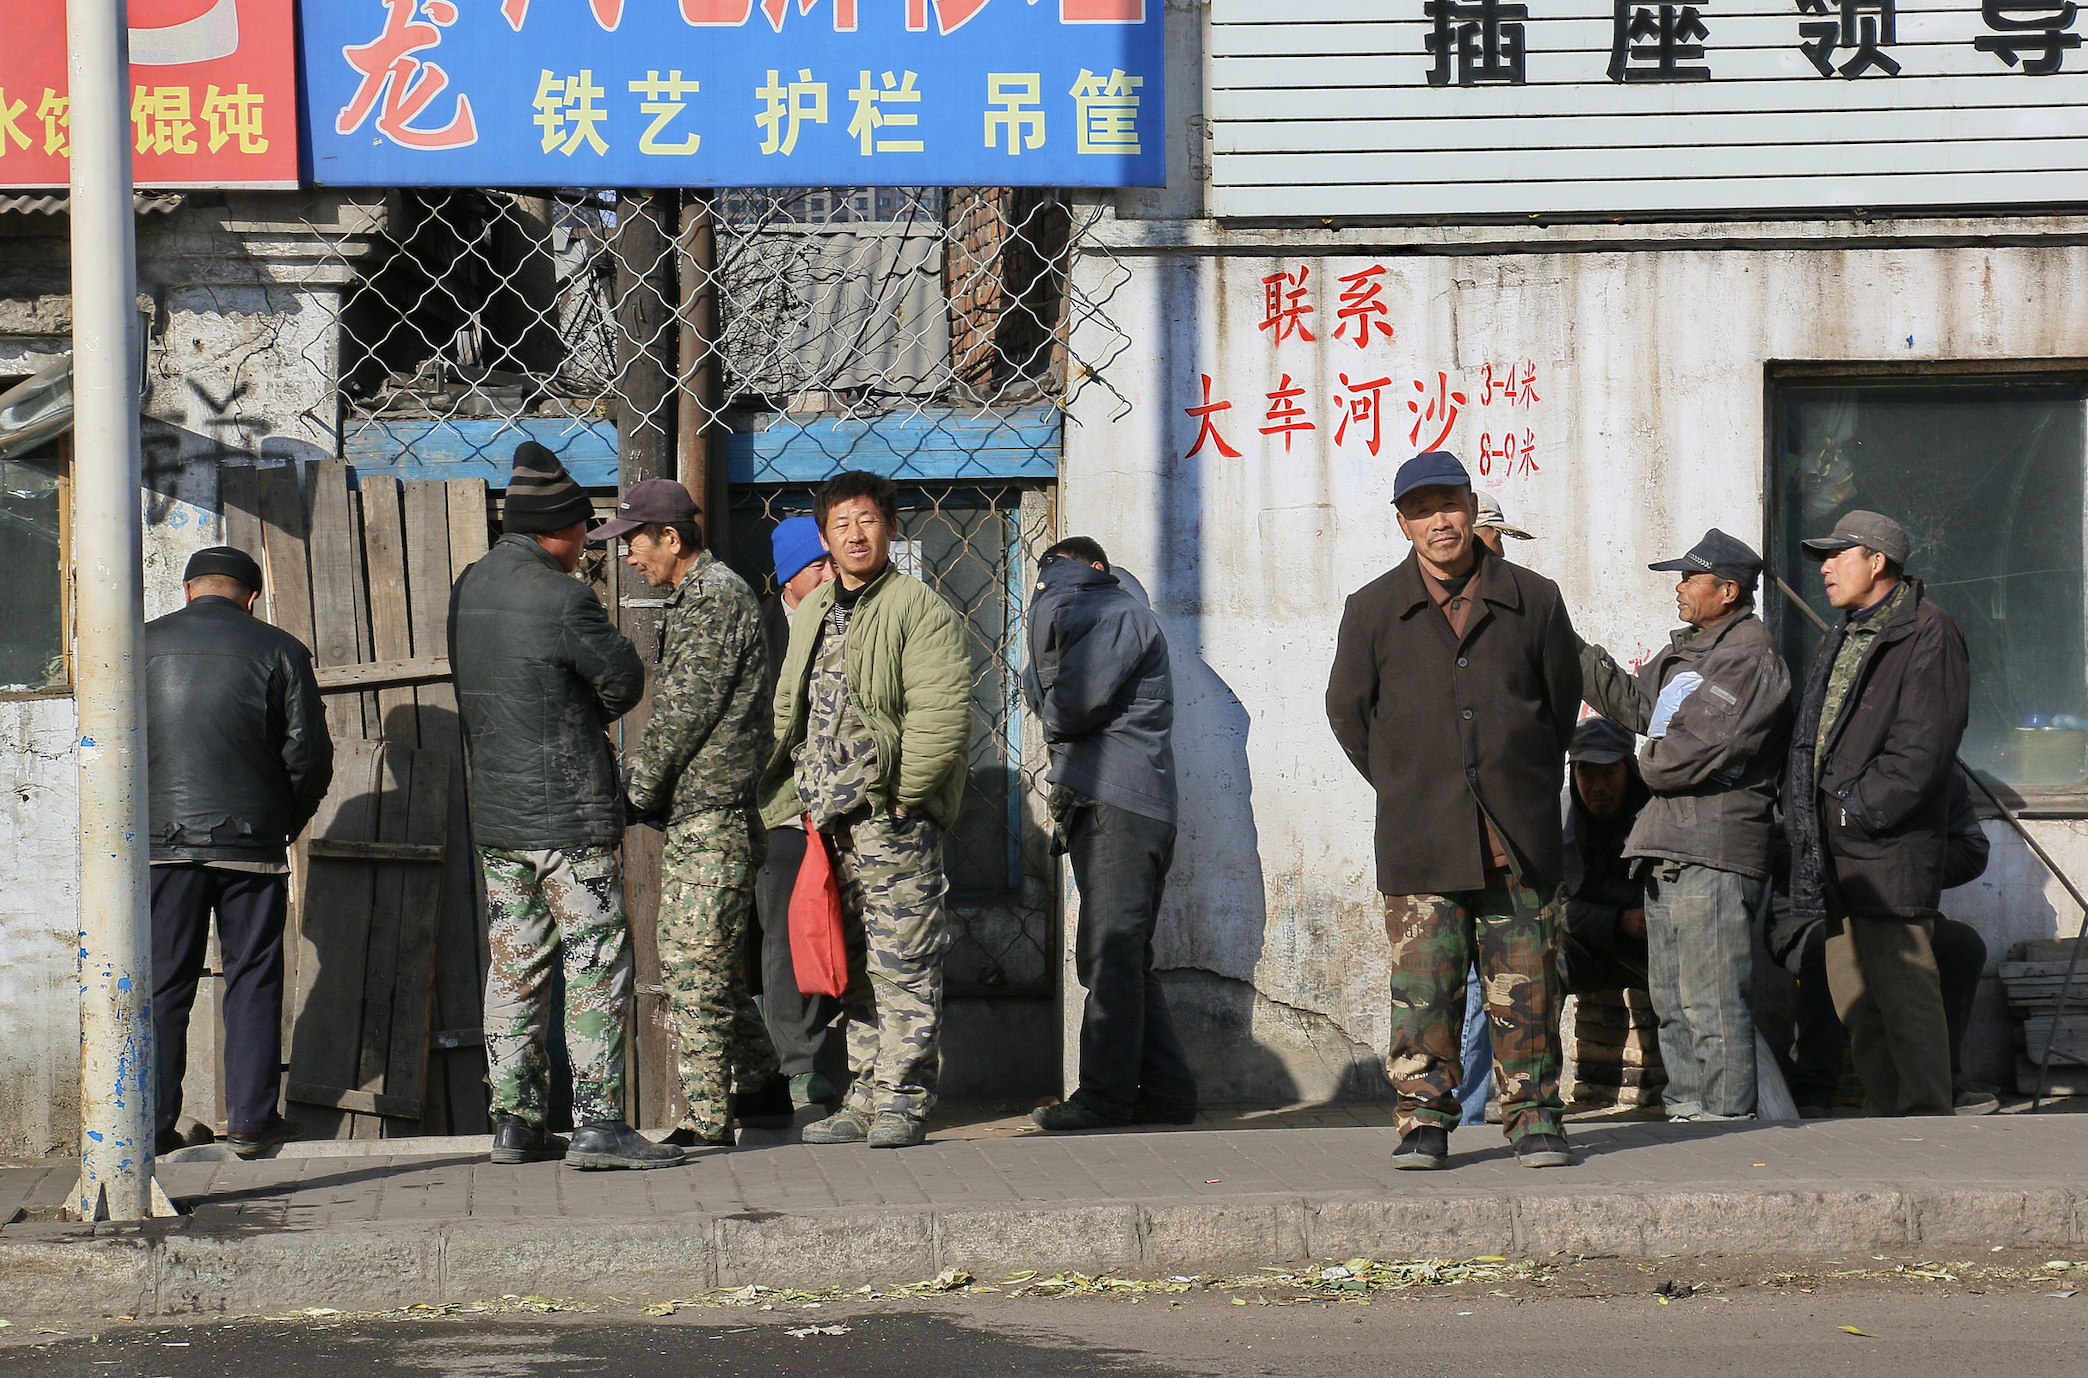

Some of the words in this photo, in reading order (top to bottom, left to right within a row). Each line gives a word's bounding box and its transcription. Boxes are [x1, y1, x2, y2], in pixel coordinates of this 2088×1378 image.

[335, 0, 478, 150] 龙
[1424, 0, 2082, 85] 插座领导
[131, 84, 269, 156] 馄饨
[532, 69, 701, 156] 铁艺
[755, 69, 924, 156] 护栏
[984, 68, 1143, 155] 吊筐
[1258, 264, 1394, 349] 联系
[1185, 371, 1467, 458] 大车河沙
[1480, 358, 1541, 411] 3-4米
[1479, 426, 1540, 477] 8-9米
